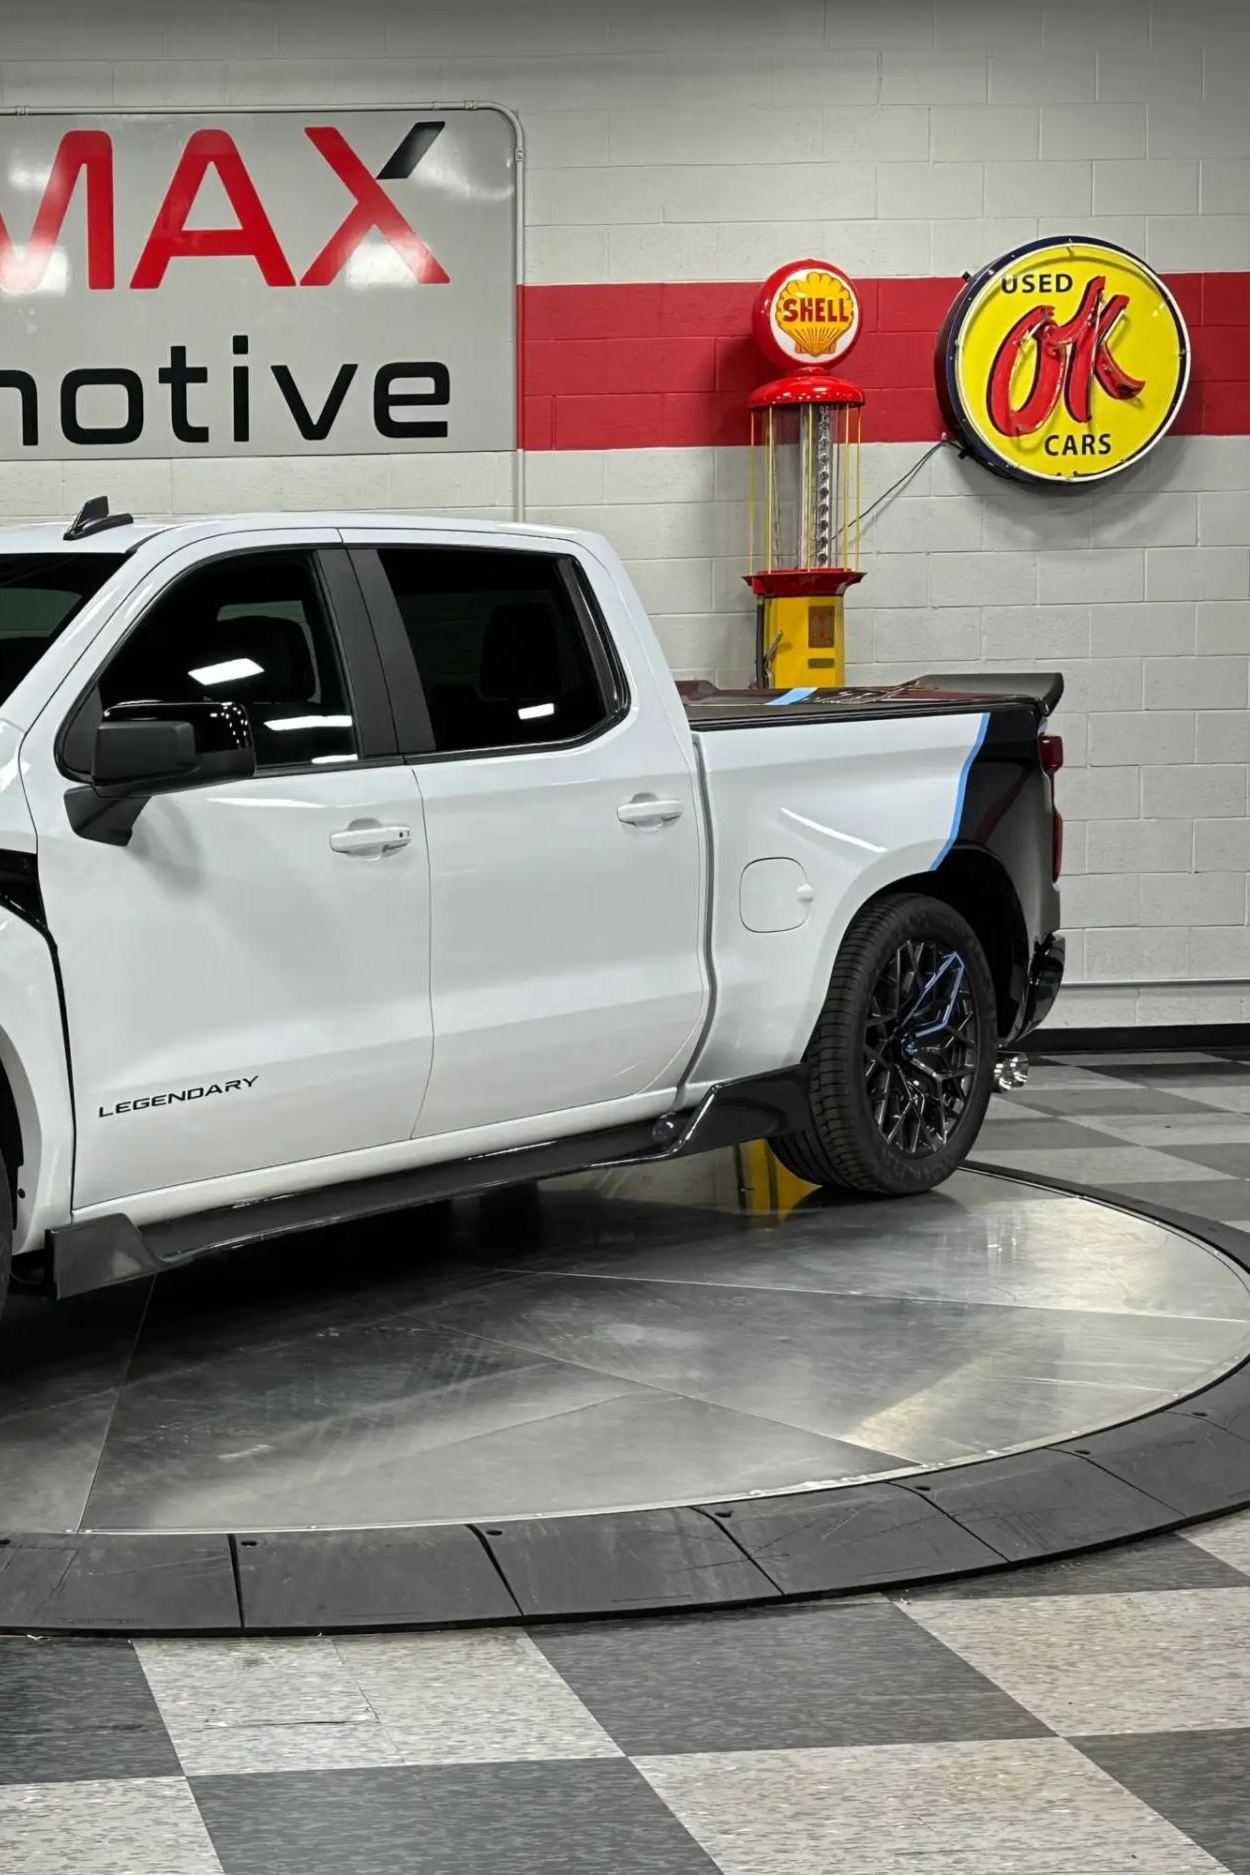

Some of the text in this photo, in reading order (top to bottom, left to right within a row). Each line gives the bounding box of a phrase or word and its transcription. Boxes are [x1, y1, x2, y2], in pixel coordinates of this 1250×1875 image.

[1001, 274, 1073, 294] USED
[782, 297, 850, 323] SHELL
[986, 276, 1146, 437] OK
[1044, 433, 1112, 456] CARS
[99, 1075, 259, 1118] LEGENDARY
